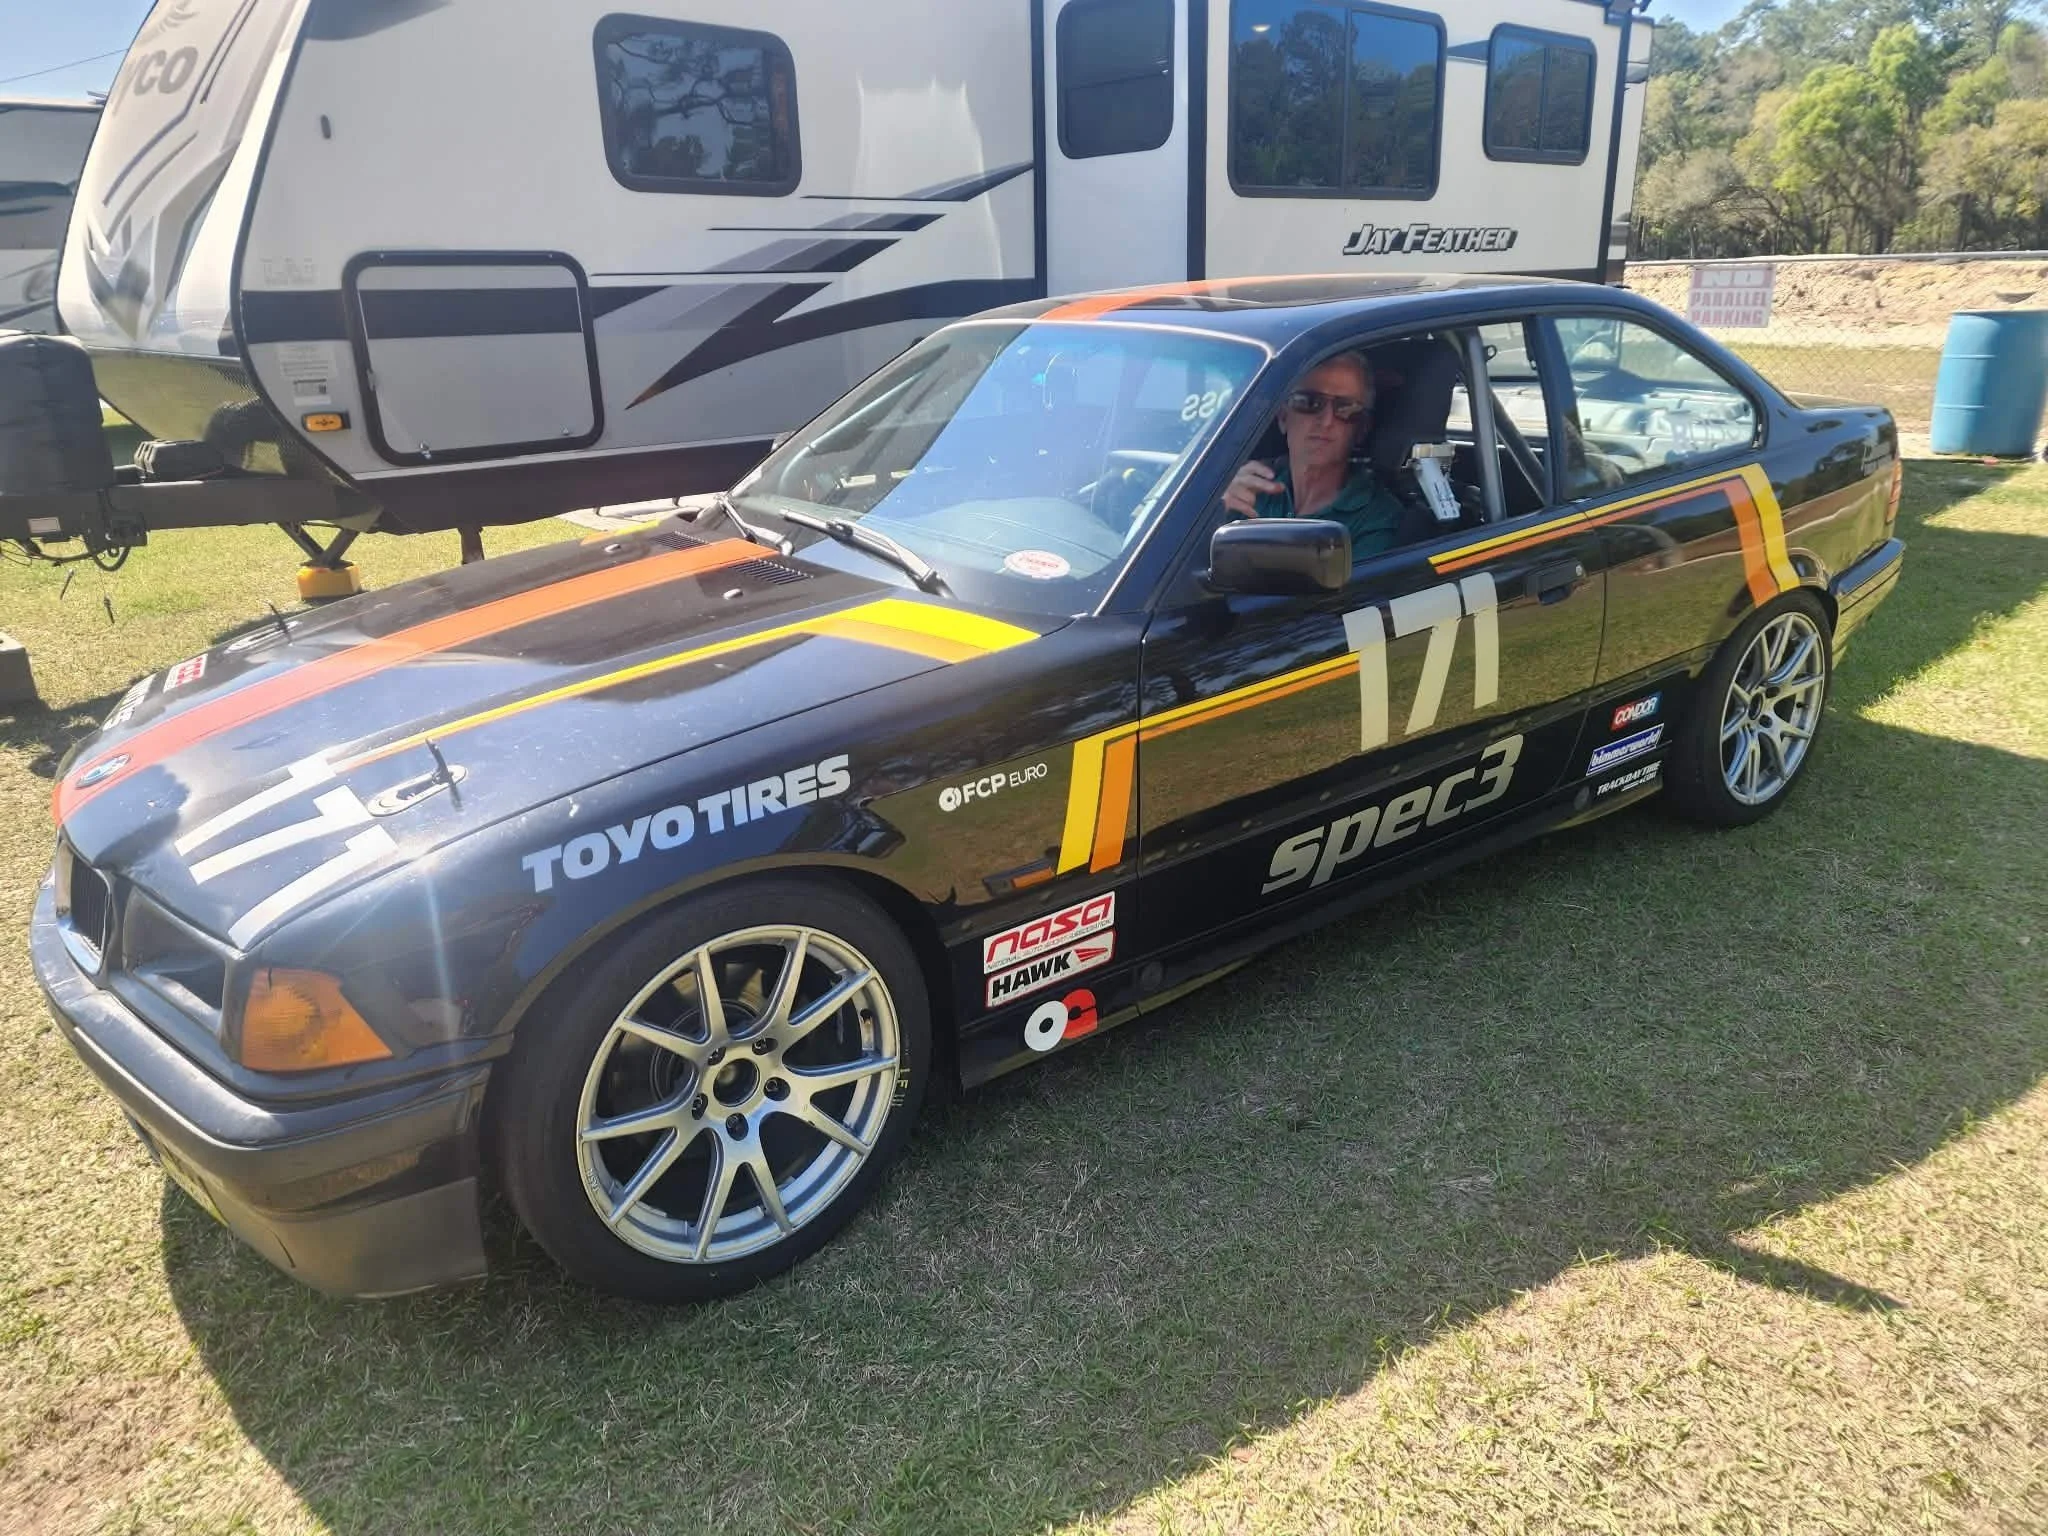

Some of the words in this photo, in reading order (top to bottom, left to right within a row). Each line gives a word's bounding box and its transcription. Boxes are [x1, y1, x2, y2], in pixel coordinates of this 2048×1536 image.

[1343, 224, 1401, 256] JAY
[1402, 223, 1512, 254] FEATHER
[1701, 269, 1765, 288] NO
[1690, 290, 1768, 307] PARALLEL
[1690, 309, 1763, 326] PARKING
[1341, 571, 1499, 752] 171
[1614, 696, 1658, 725] CONDOR
[962, 772, 1007, 804] FCP
[1008, 762, 1049, 788] EURO
[522, 804, 696, 894] TOYO
[696, 753, 852, 835] TIRES
[1260, 733, 1525, 896] spec3
[992, 951, 1073, 999] HAWK
